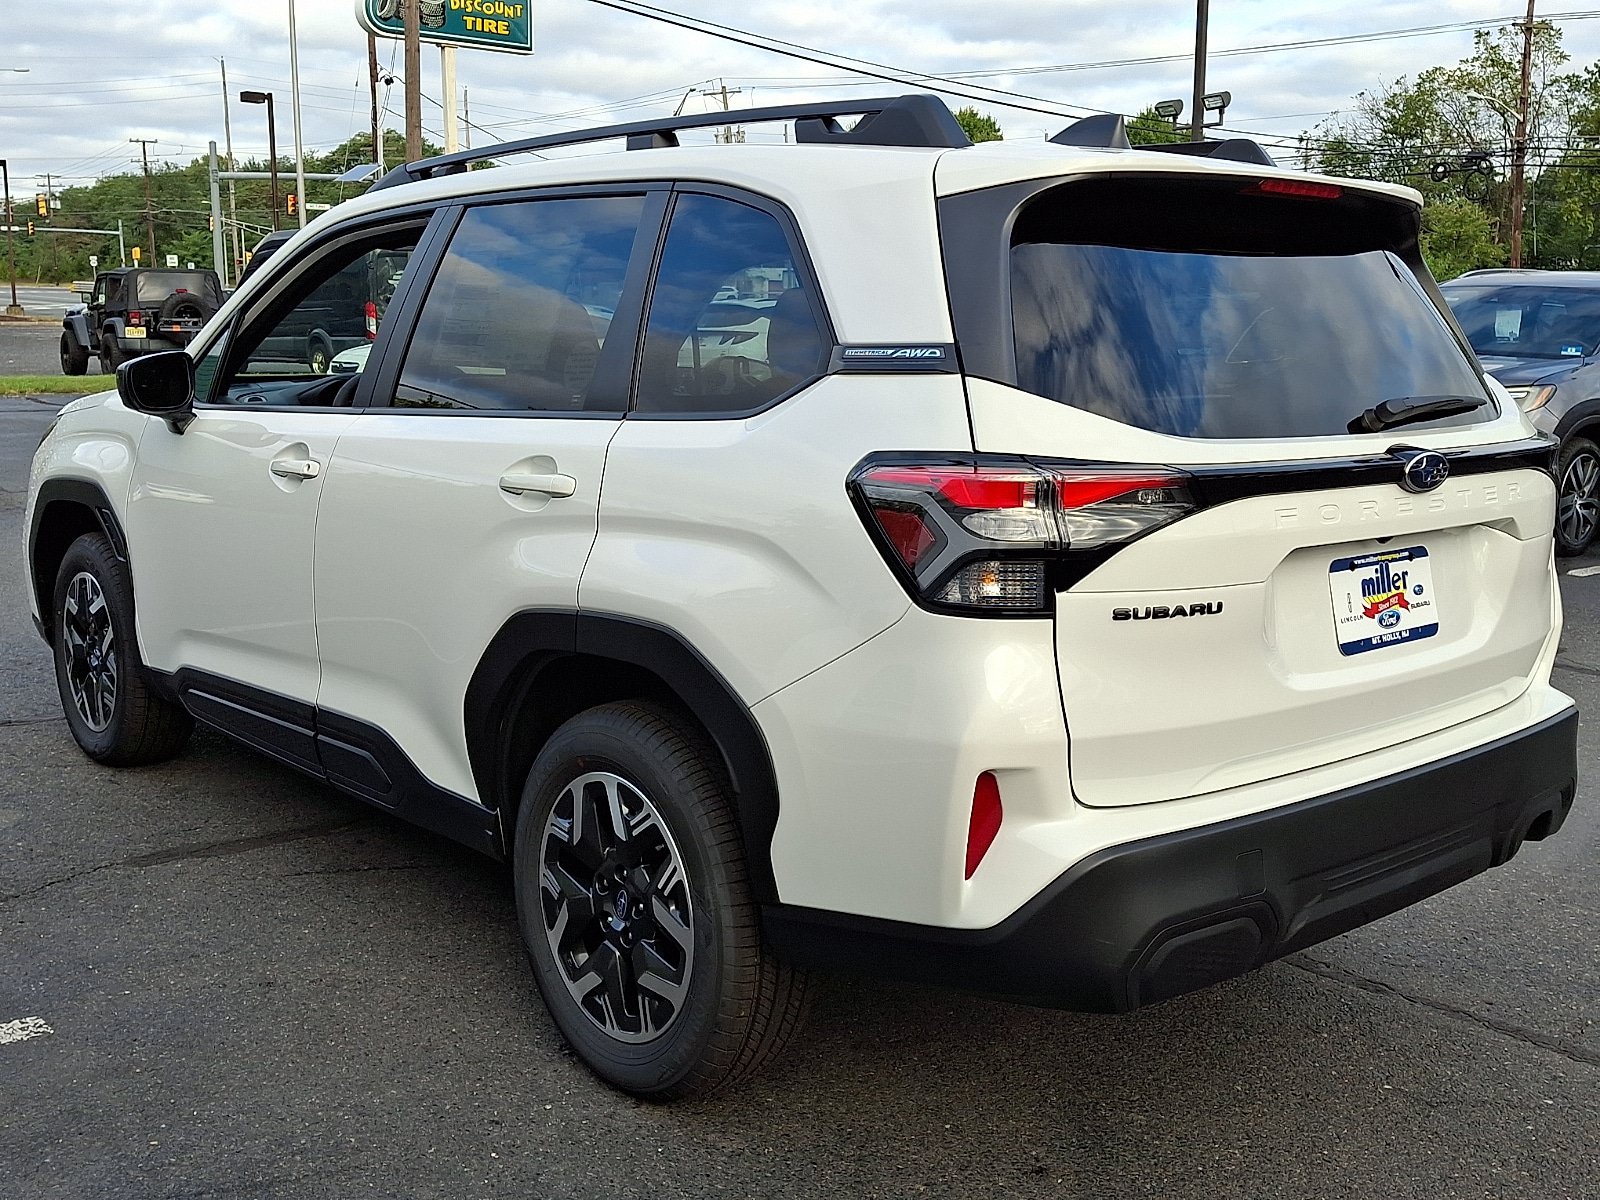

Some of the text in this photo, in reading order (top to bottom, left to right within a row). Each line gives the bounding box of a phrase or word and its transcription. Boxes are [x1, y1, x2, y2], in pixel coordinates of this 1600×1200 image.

[450, 0, 524, 18] DISCOUNT
[463, 16, 510, 35] TIRE
[846, 348, 941, 358] SYMMETRICAL AWD
[1274, 482, 1523, 530] FORESTER
[1361, 562, 1408, 597] miller
[1112, 601, 1223, 621] SUBARU
[1340, 615, 1364, 624] LINCOLN
[1381, 611, 1398, 626] Ford
[1382, 631, 1401, 643] HOLLY,
[1401, 630, 1410, 638] NJ
